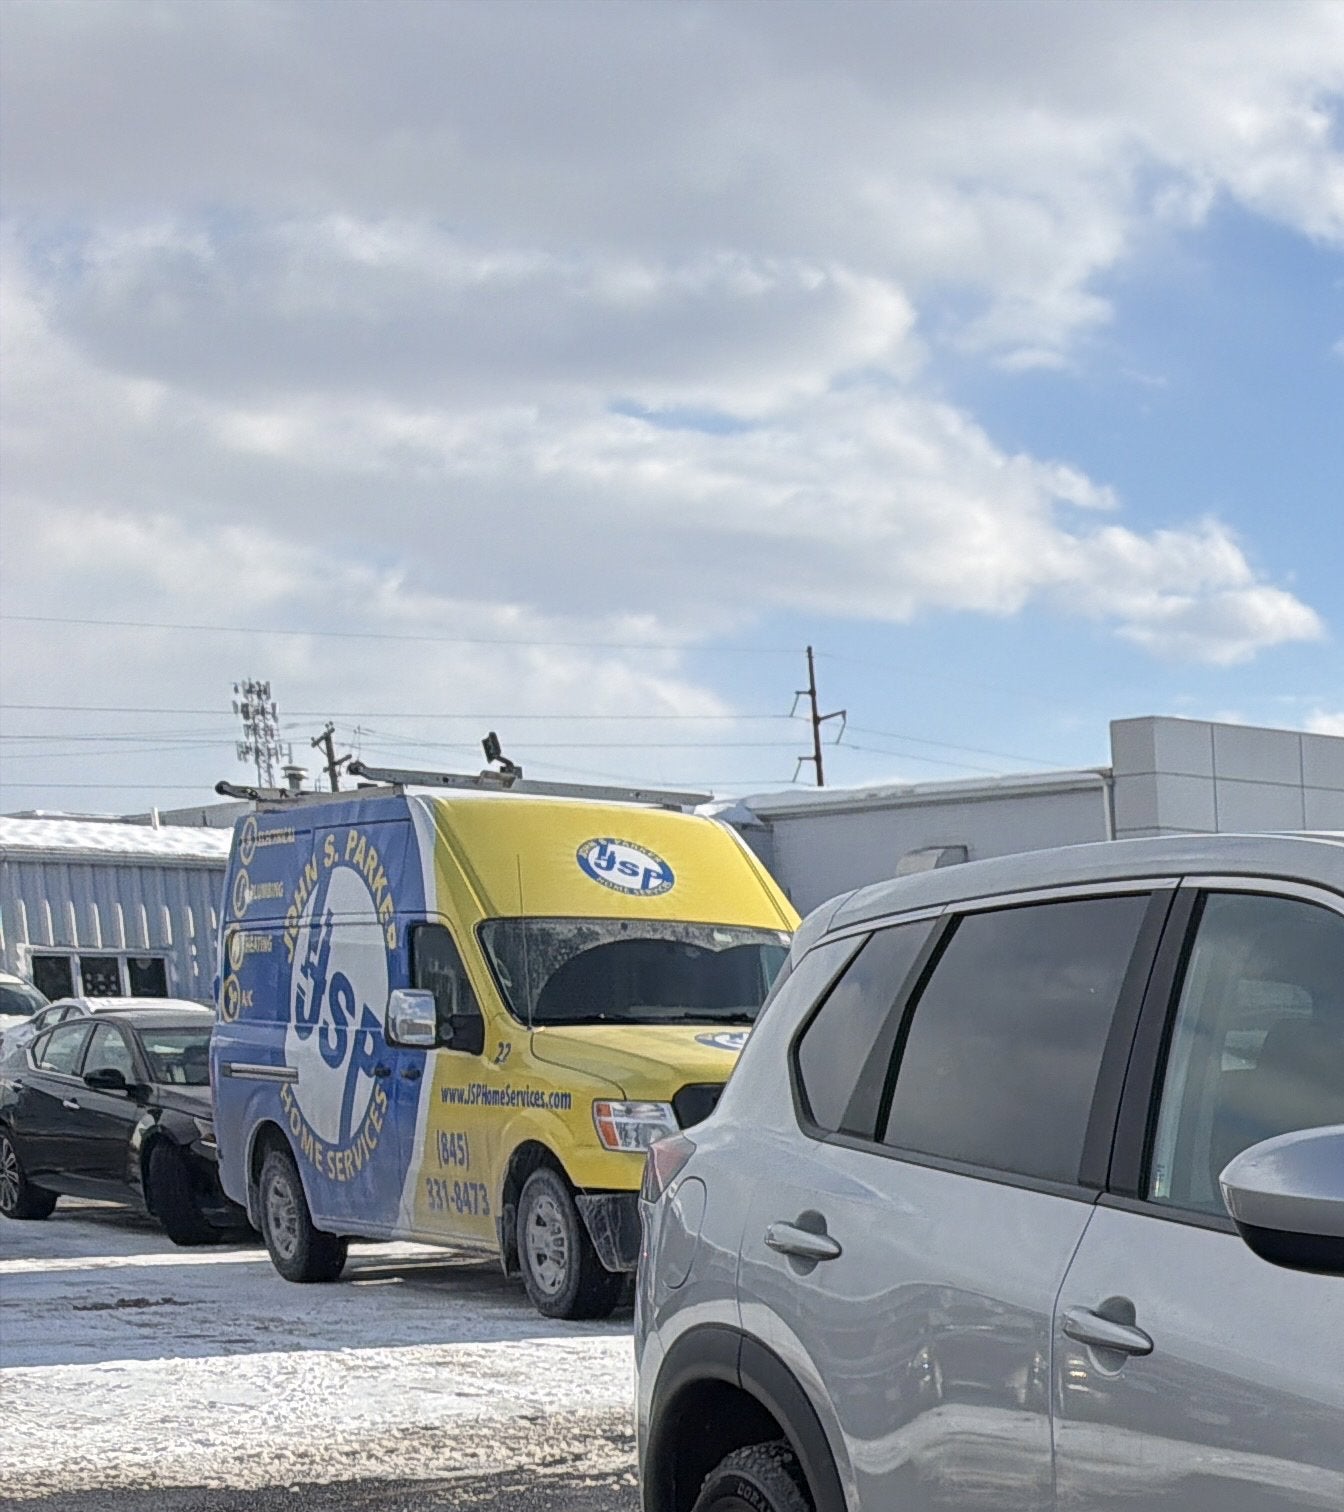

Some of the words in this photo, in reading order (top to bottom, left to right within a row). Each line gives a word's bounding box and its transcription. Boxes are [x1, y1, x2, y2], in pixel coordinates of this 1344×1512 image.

[284, 853, 318, 964] JOHN
[324, 833, 339, 868] S.
[345, 829, 397, 950] PARKER
[440, 1083, 572, 1111] www.JSPHomeServices.com
[280, 1083, 324, 1173] HOME
[327, 1086, 388, 1182] SERVICES
[436, 1129, 470, 1172] (845)
[425, 1177, 491, 1218] 331-8473
